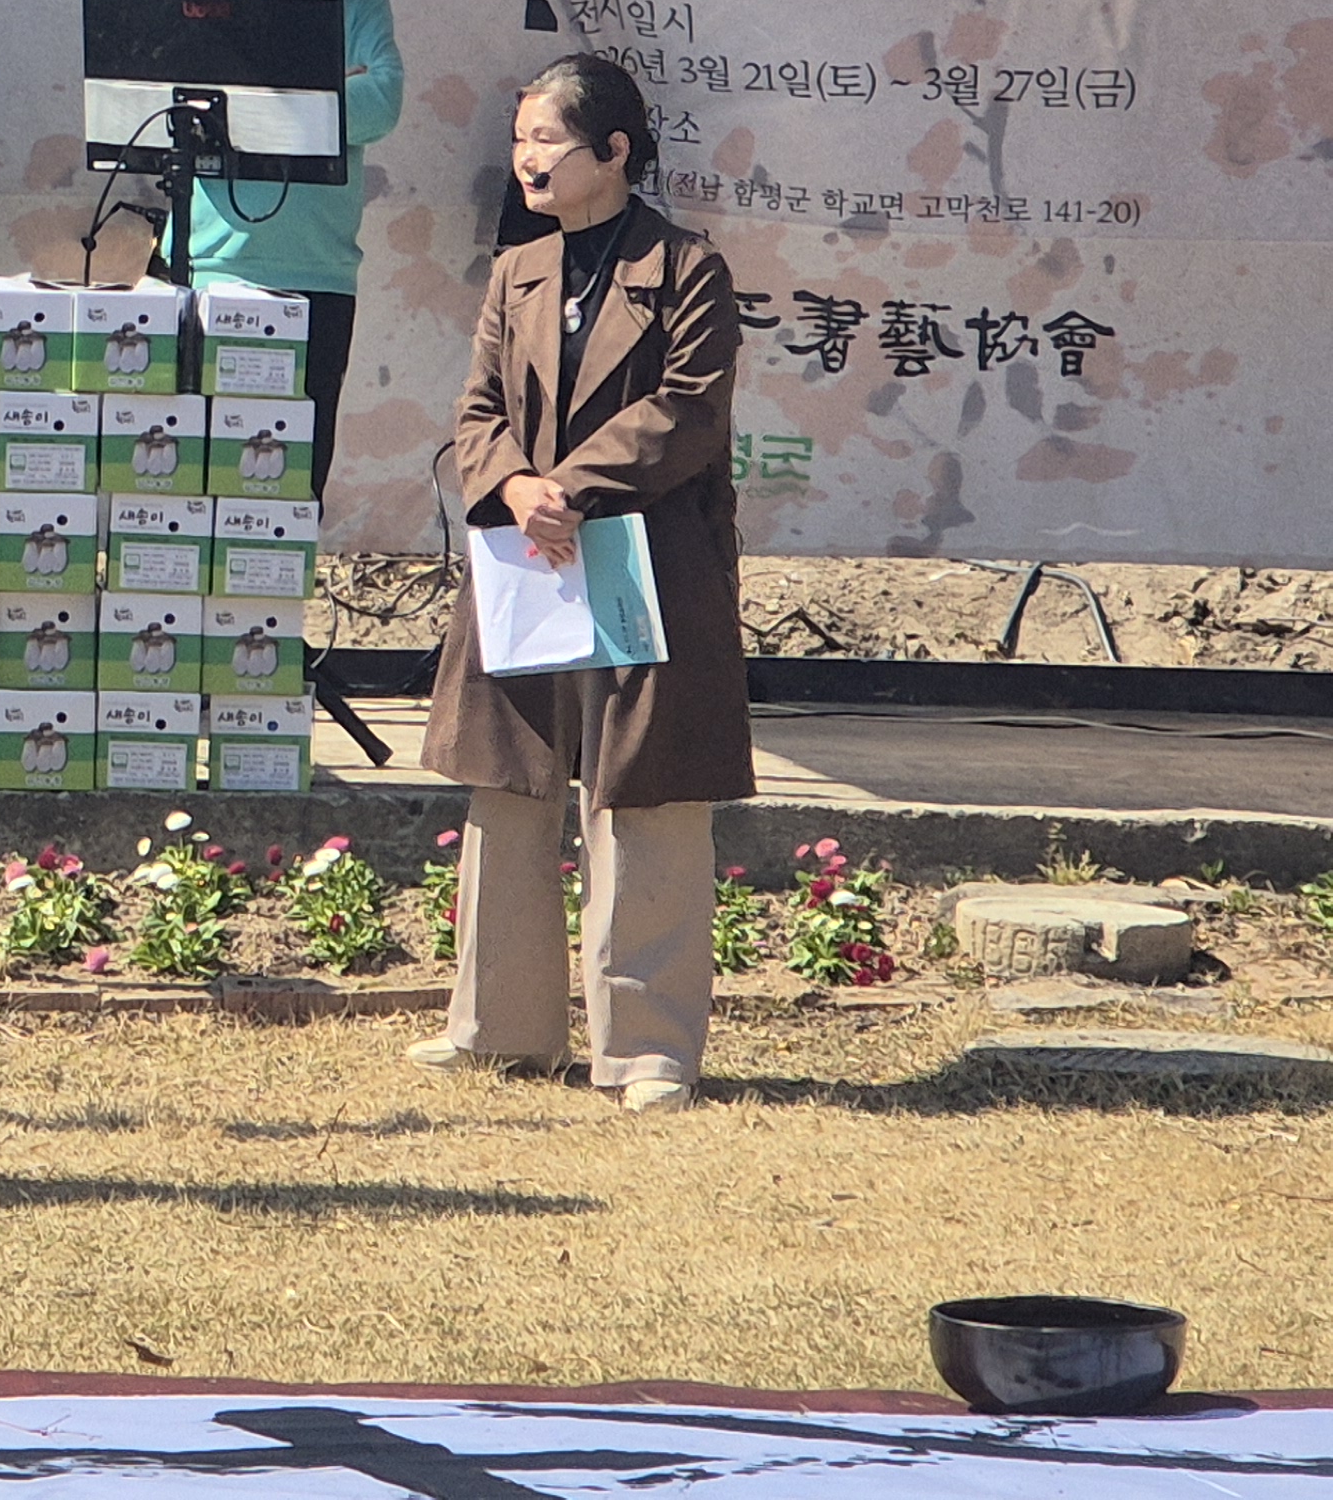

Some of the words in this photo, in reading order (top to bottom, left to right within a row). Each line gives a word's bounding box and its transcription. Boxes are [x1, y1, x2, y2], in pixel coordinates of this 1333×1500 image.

[678, 53, 732, 93] 3월
[742, 59, 877, 104] 21일(토)
[922, 64, 980, 107] 3월
[994, 66, 1136, 111] 27일(금)
[734, 179, 811, 214] 함평군
[822, 187, 904, 222] 학교면
[916, 193, 1031, 224] 고막천로
[1043, 200, 1141, 228] 141-20)
